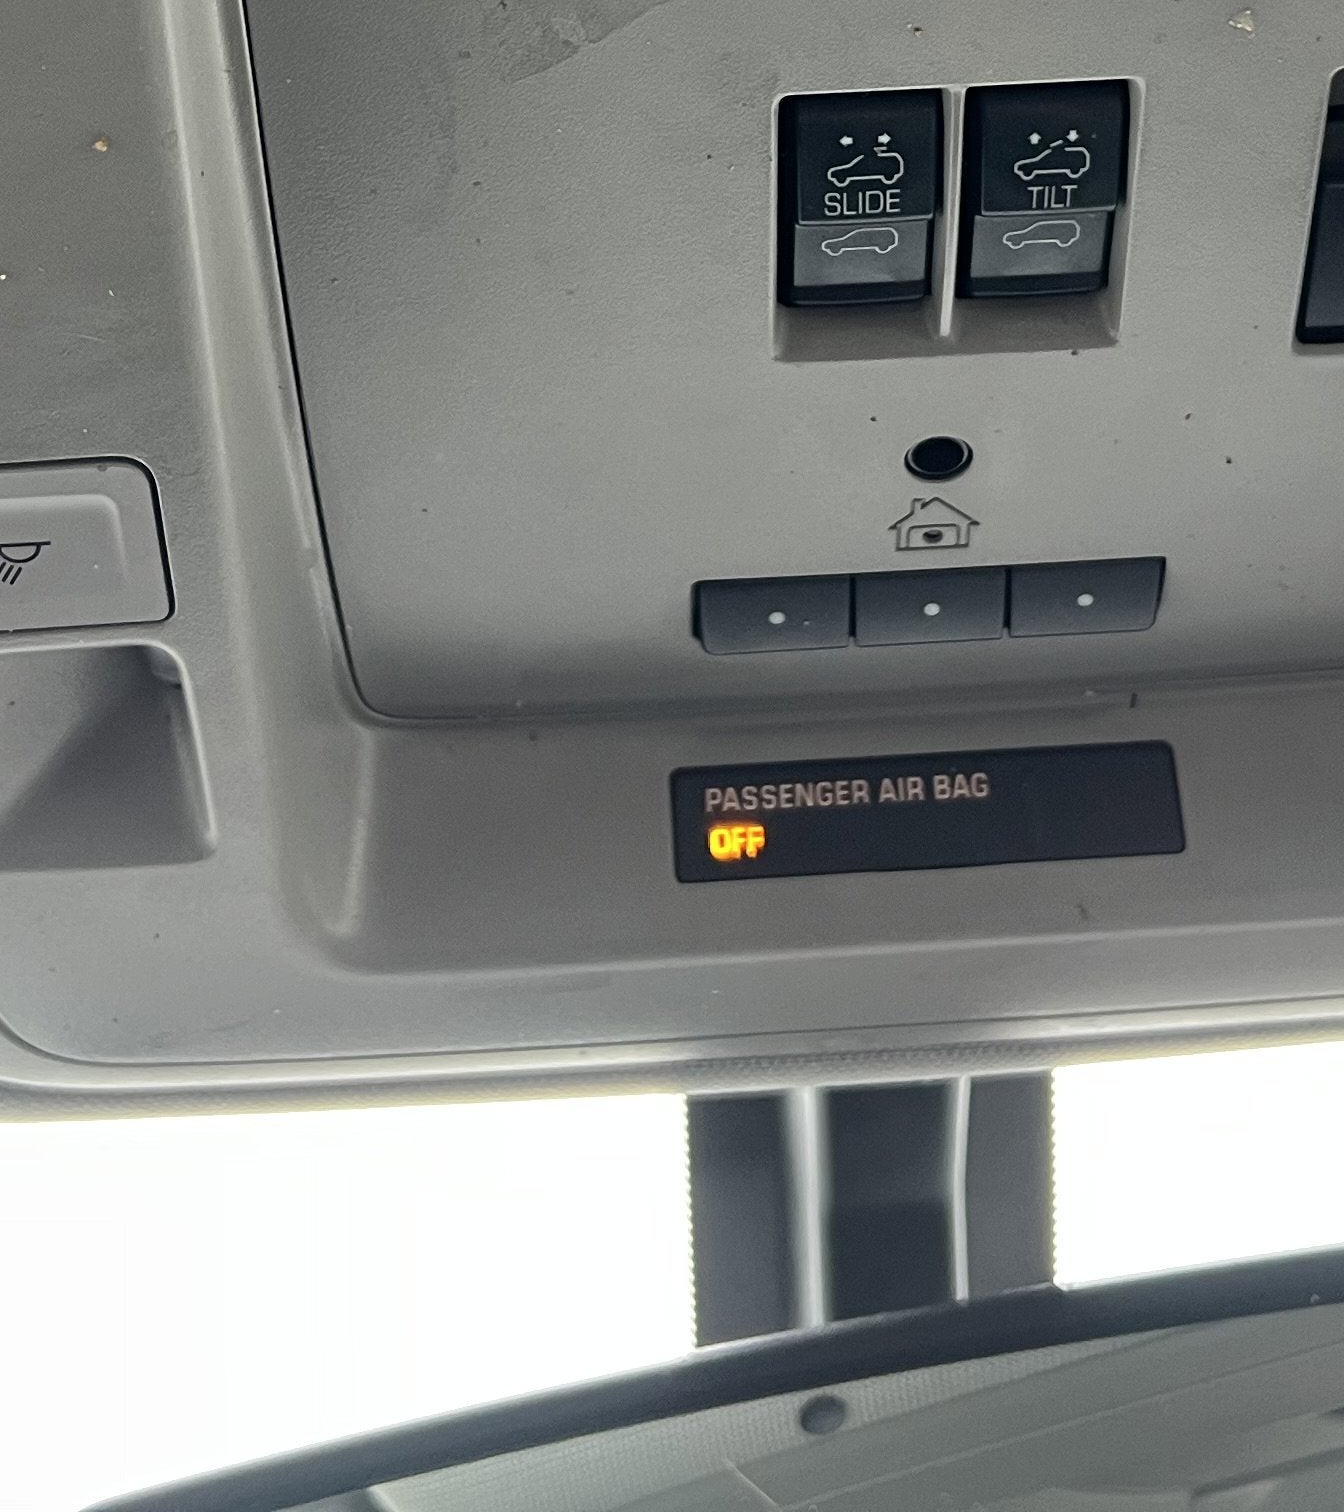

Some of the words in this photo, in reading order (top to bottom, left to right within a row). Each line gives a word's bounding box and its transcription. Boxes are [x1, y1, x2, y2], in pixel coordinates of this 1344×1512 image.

[824, 189, 901, 216] SLIDE
[1027, 185, 1078, 209] TILT
[704, 779, 872, 813] PASSENGER
[878, 775, 926, 803] AIR
[933, 772, 990, 799] BAG
[708, 823, 766, 862] OFF
